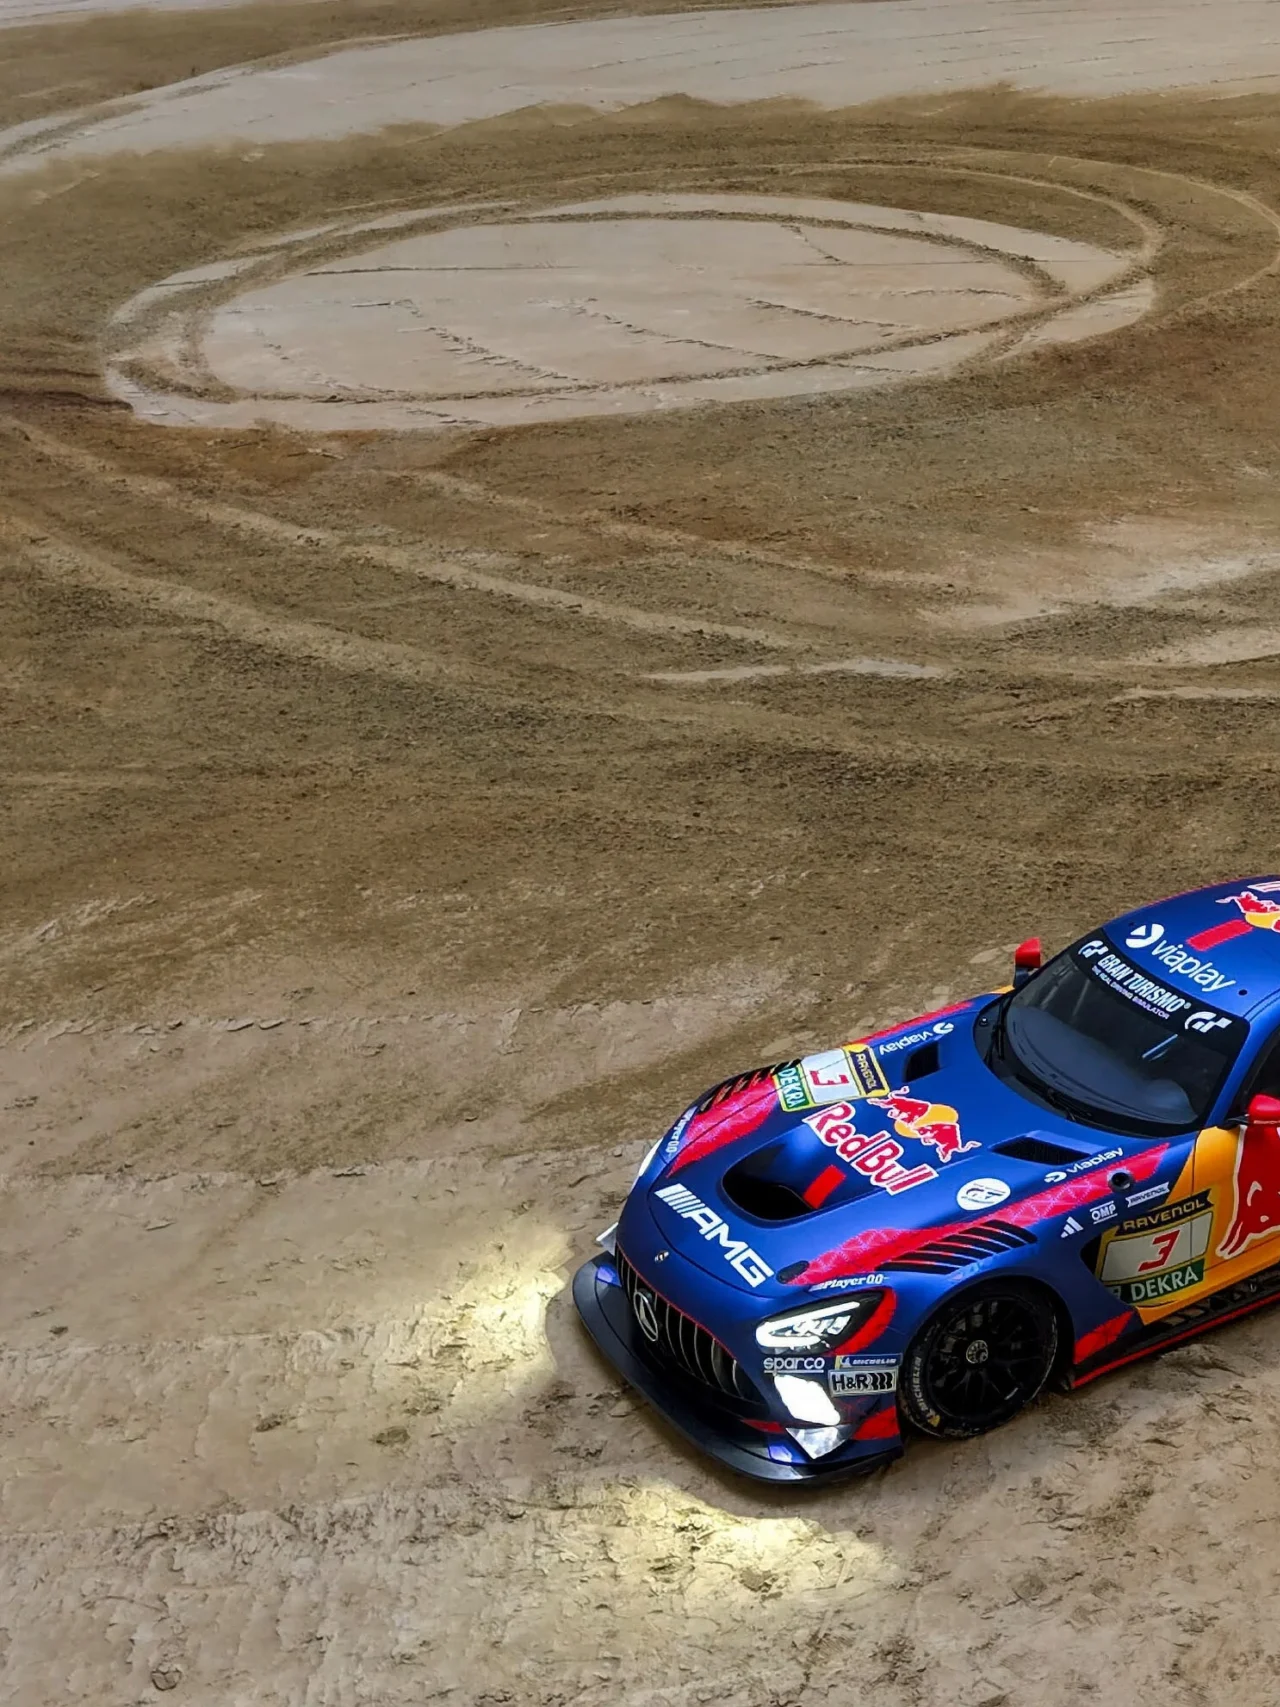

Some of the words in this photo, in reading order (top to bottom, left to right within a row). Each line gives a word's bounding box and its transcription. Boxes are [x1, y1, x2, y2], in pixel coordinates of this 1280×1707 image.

[1151, 940, 1236, 992] viaplay
[1098, 954, 1134, 980] GRAN
[1123, 973, 1186, 1012] TURISMO
[879, 1032, 933, 1055] viaplay
[778, 1066, 807, 1108] DEKRA
[809, 1070, 849, 1086] 3
[802, 1101, 891, 1162] Red
[851, 1140, 939, 1195] Bull
[1066, 1147, 1123, 1173] viaplay
[1091, 1204, 1116, 1220] OMP
[1123, 1199, 1205, 1231] RAVENOL
[681, 1206, 774, 1288] AMG
[1138, 1229, 1181, 1272] 3
[1130, 1266, 1199, 1300] DEKRA
[763, 1357, 825, 1375] sparco
[832, 1372, 869, 1391] H&R
